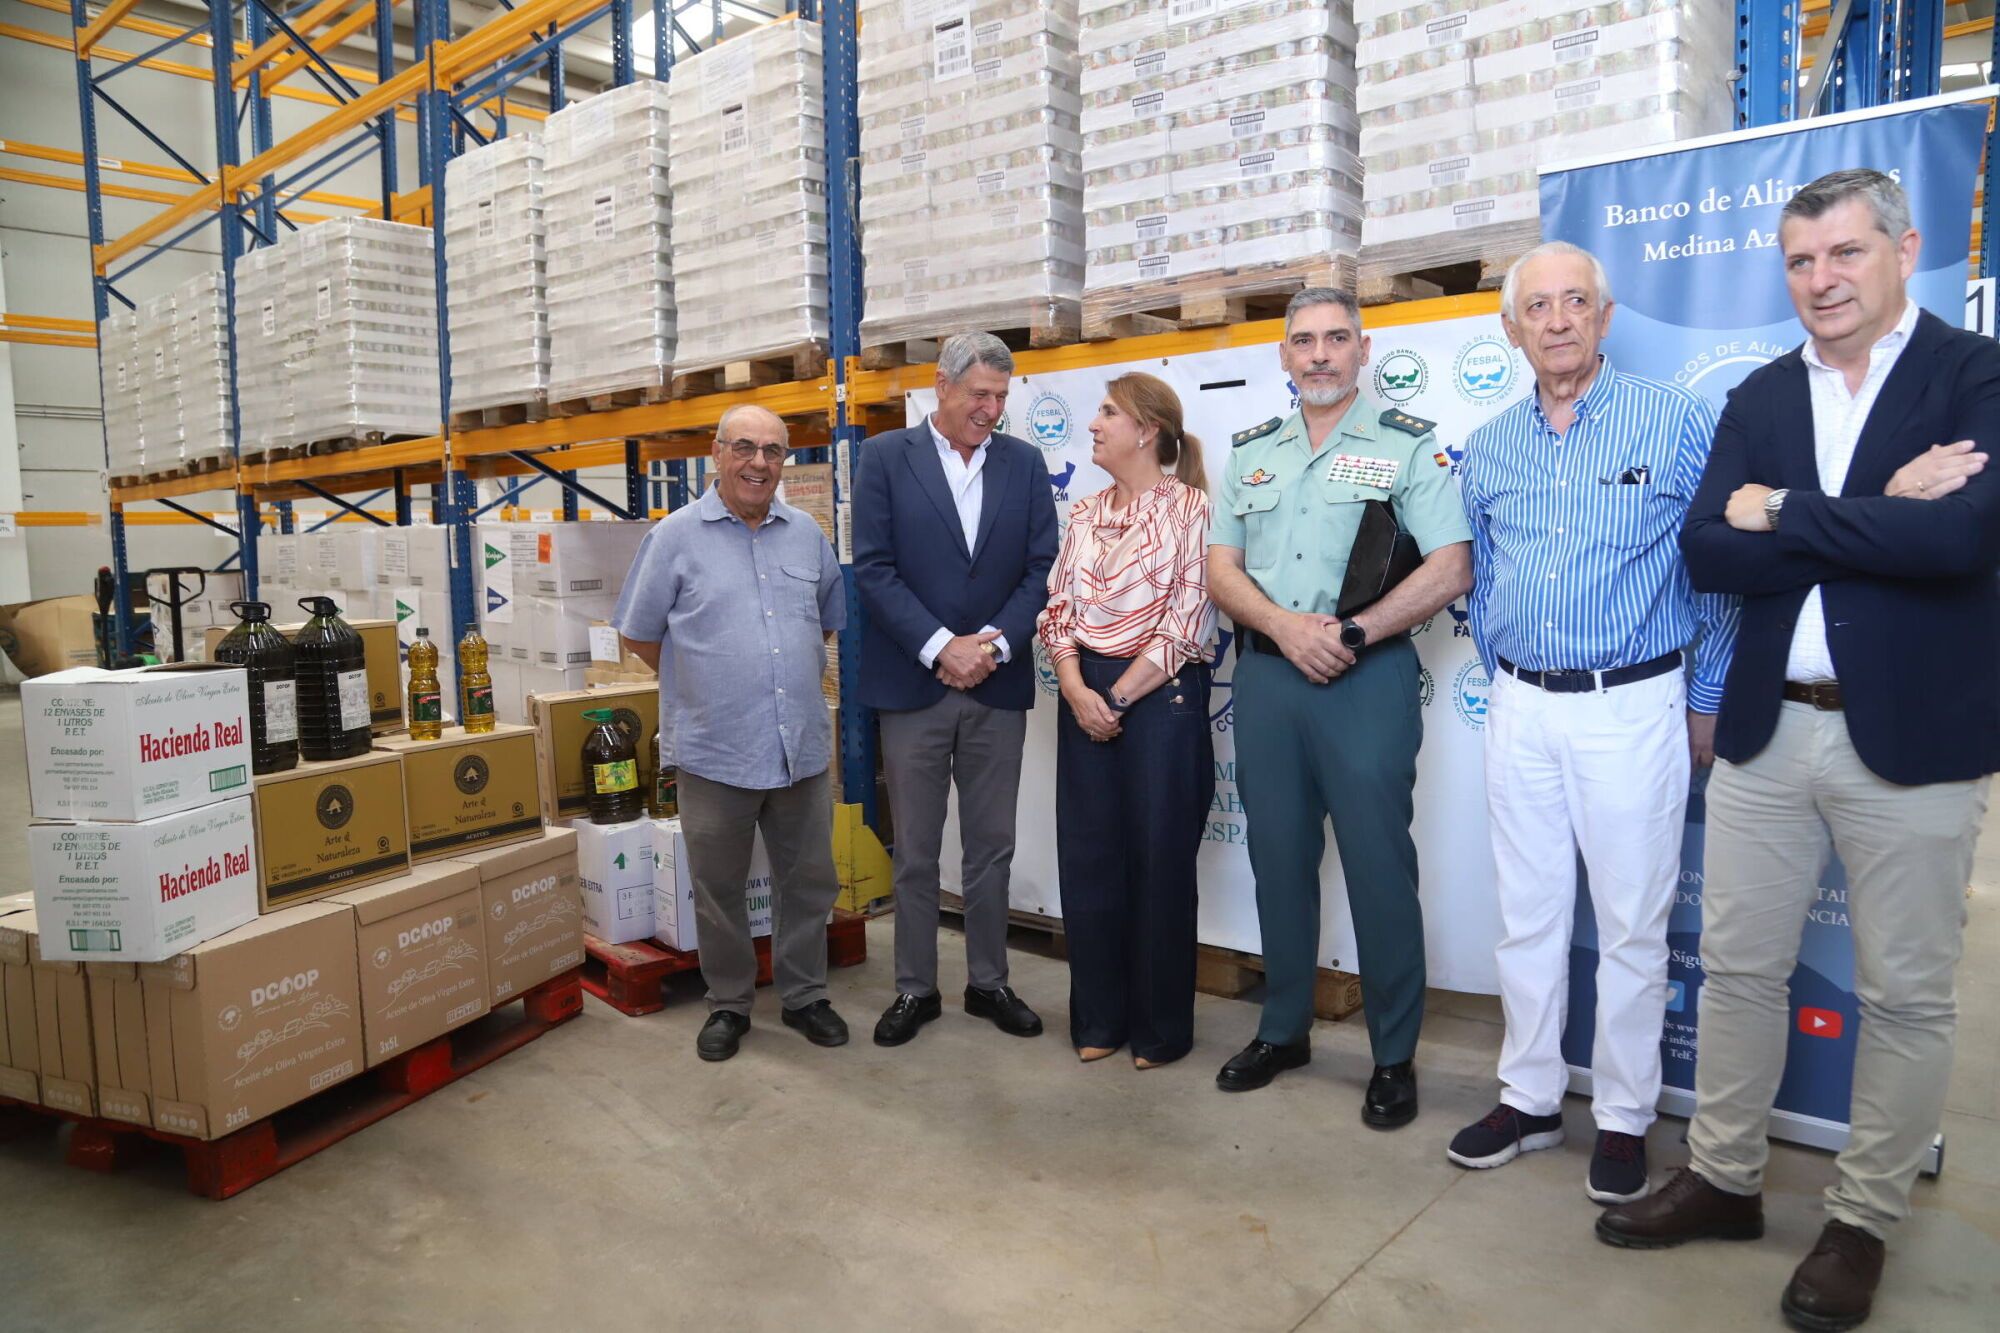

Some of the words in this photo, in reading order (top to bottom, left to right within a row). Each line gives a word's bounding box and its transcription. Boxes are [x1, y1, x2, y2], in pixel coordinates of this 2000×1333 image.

[1603, 200, 1690, 229] Banco
[1699, 186, 1732, 214] de
[1643, 233, 1735, 263] Medina
[1744, 228, 1779, 254] Az
[1467, 355, 1503, 366] FESBAL
[1674, 352, 1710, 383] COS
[1715, 341, 1741, 357] DE
[1036, 409, 1062, 417] FESBAL
[1054, 492, 1069, 501] CM
[1453, 626, 1470, 638] FA
[136, 694, 162, 706] Aceite
[164, 692, 172, 702] de
[176, 689, 195, 700] Oliva
[199, 685, 221, 701] Virgen
[223, 683, 240, 694] Extra
[43, 708, 53, 717] 12
[54, 708, 91, 717] ENVASES
[93, 708, 105, 717] DE
[63, 718, 93, 726] LITROS
[139, 722, 210, 763] Hacienda
[214, 715, 243, 749] Real
[462, 800, 478, 810] Arte
[455, 809, 496, 825] Naturaleza
[53, 843, 62, 851] 12
[64, 842, 105, 851] ENVASES
[108, 842, 121, 851] DE
[324, 834, 342, 847] Arte
[75, 852, 107, 860] LITROS
[316, 845, 361, 864] Naturaleza
[102, 876, 118, 885] por:
[159, 856, 221, 903] Hacienda
[223, 844, 250, 879] Real
[328, 869, 354, 880] ACEITES
[512, 876, 556, 903] DCOOP
[1807, 909, 1849, 927] NCIA
[398, 917, 453, 948] DCOOP
[250, 969, 319, 1008] DCOOP
[380, 1036, 398, 1053] 3x5L
[1669, 1035, 1698, 1049] info@
[234, 1071, 260, 1089] Aceite
[262, 1066, 273, 1076] de
[275, 1057, 296, 1071] Oliva
[297, 1047, 324, 1062] Virgen
[325, 1037, 346, 1049] Extra
[1670, 1049, 1692, 1061] Telf.
[226, 1107, 250, 1128] 3x5L
